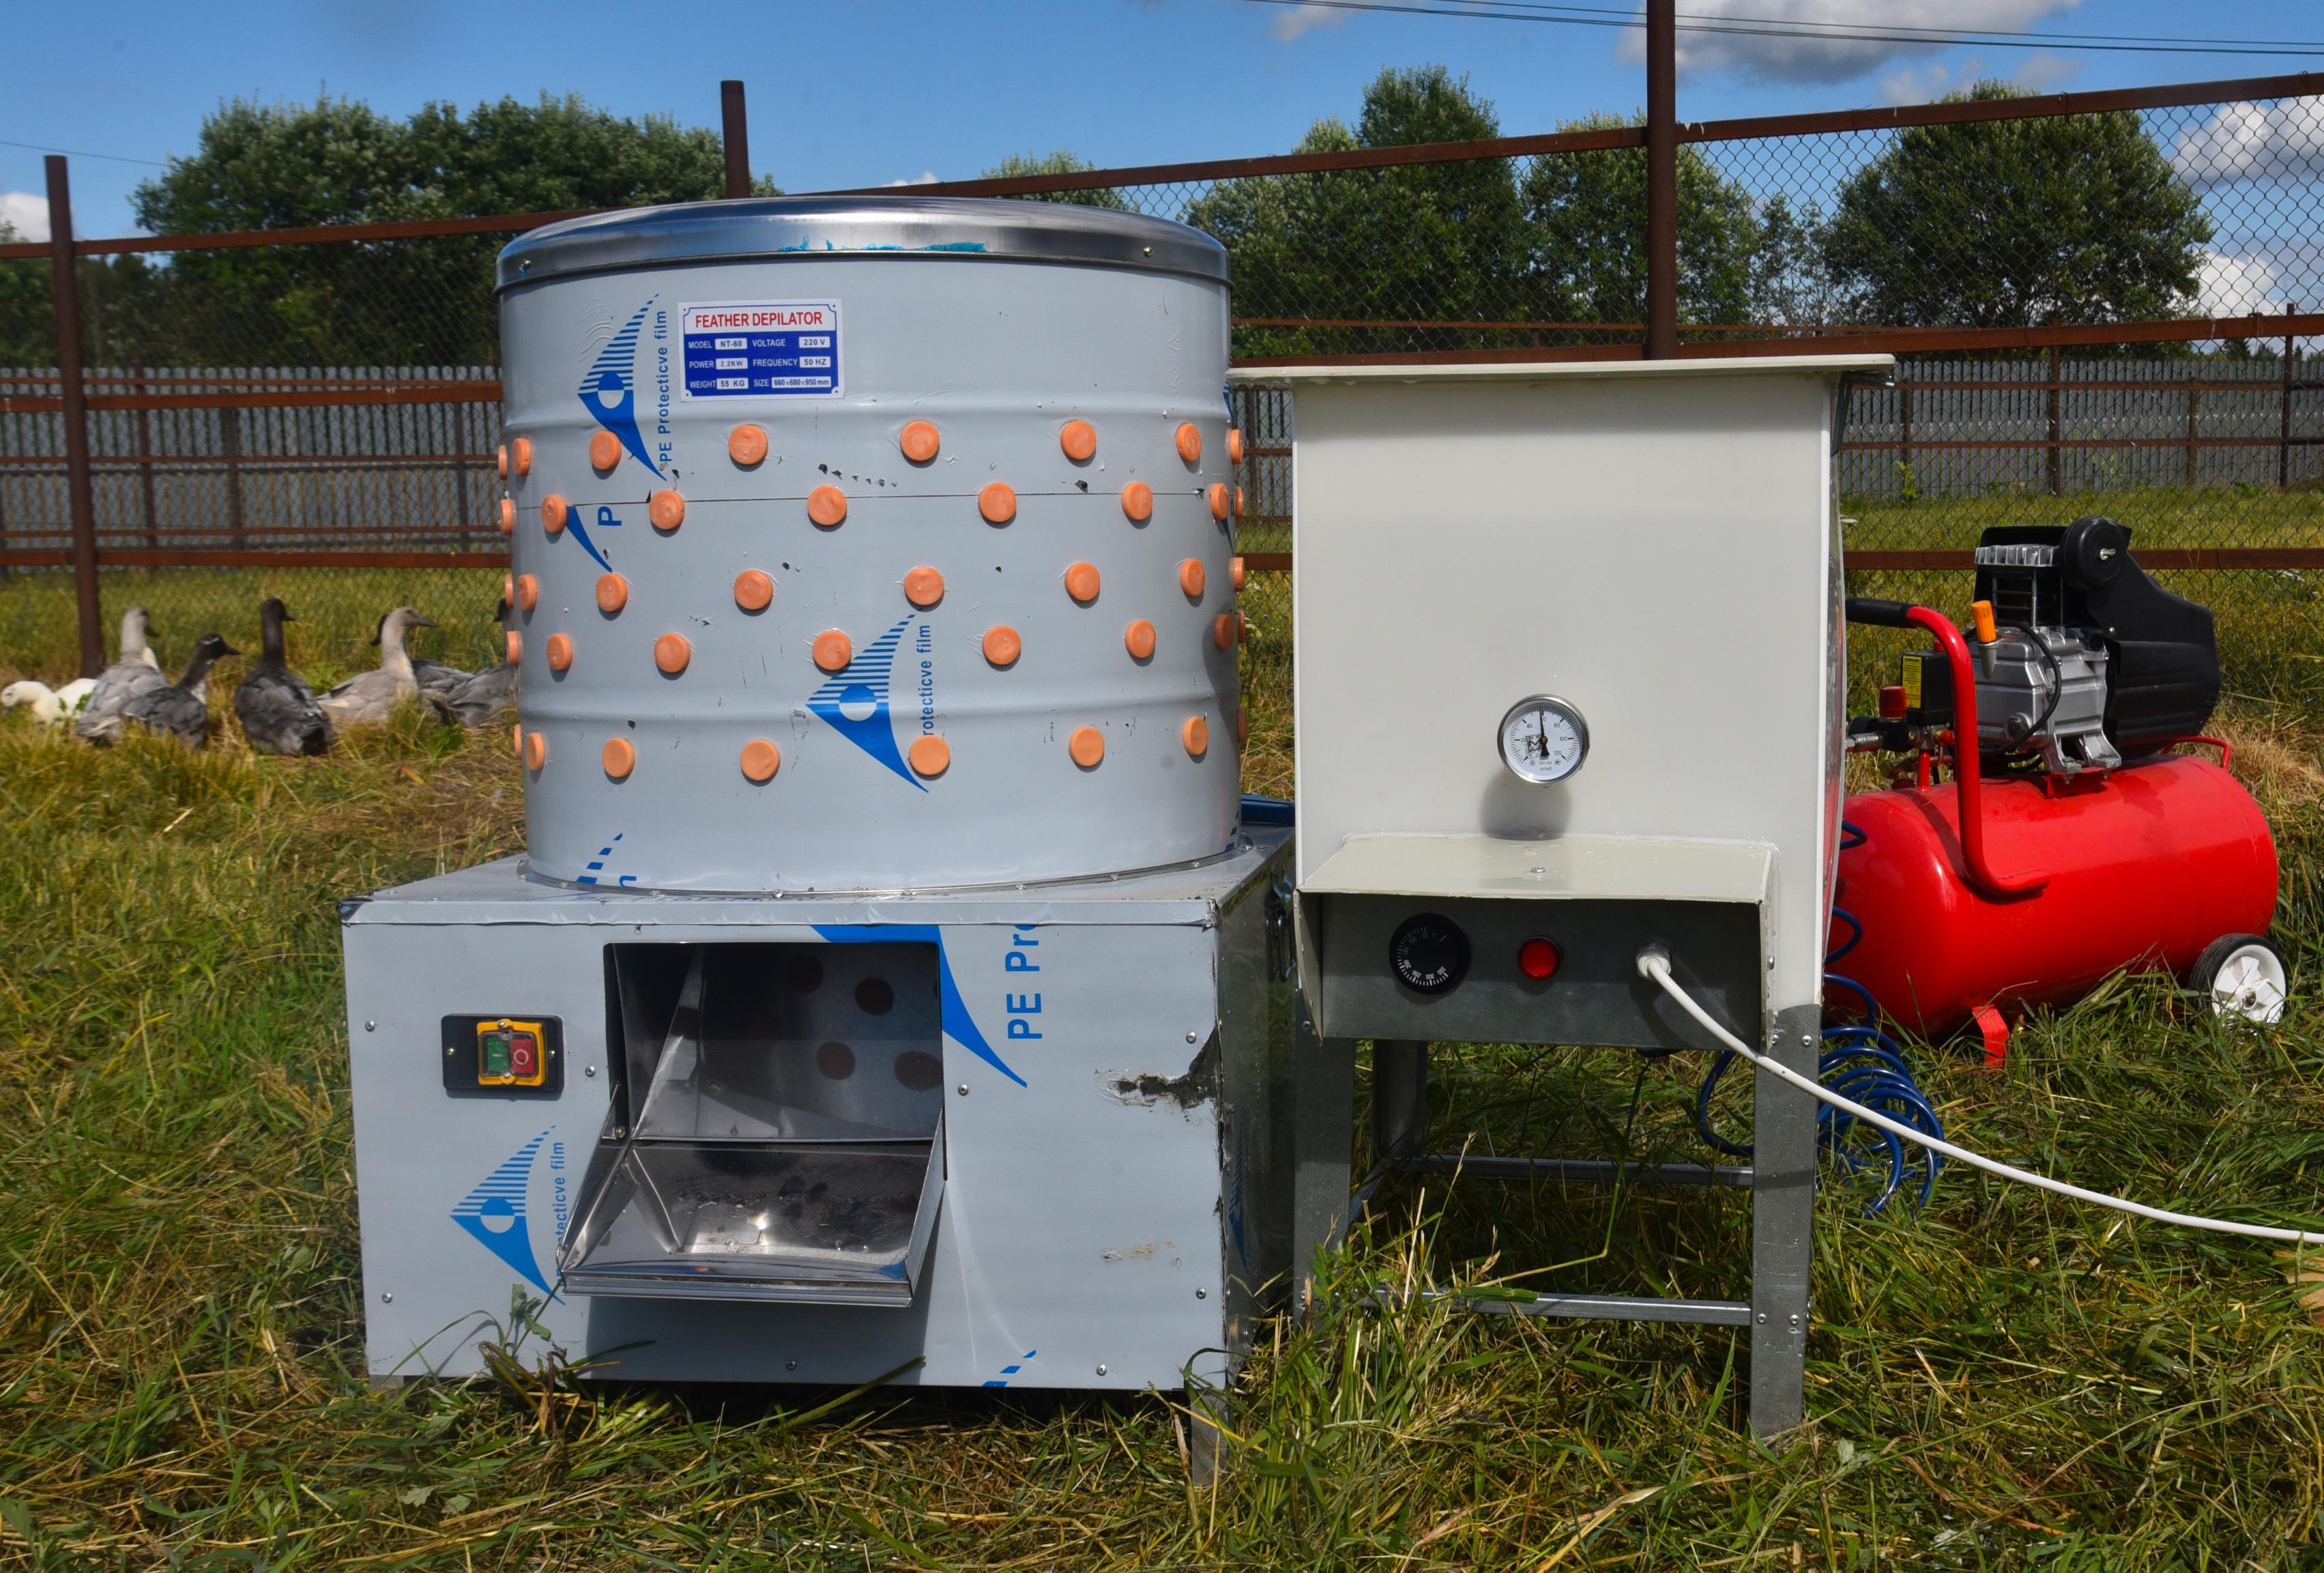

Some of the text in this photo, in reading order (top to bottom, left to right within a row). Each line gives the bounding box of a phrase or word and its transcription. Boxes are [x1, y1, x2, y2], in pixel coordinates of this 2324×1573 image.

[695, 311, 823, 328] FEATHER DEPILATOR
[688, 341, 712, 349] MODEL
[752, 339, 785, 347] VOLTAGE
[689, 360, 714, 369] POWER
[753, 358, 798, 367] FREQUENCY
[654, 311, 673, 462] PE Protecticve film
[690, 380, 716, 388] WEIGHT
[753, 379, 770, 387] SIZE
[916, 625, 933, 735] rotecticve film
[1005, 925, 1043, 1039] PE Pr
[551, 1142, 565, 1170] film
